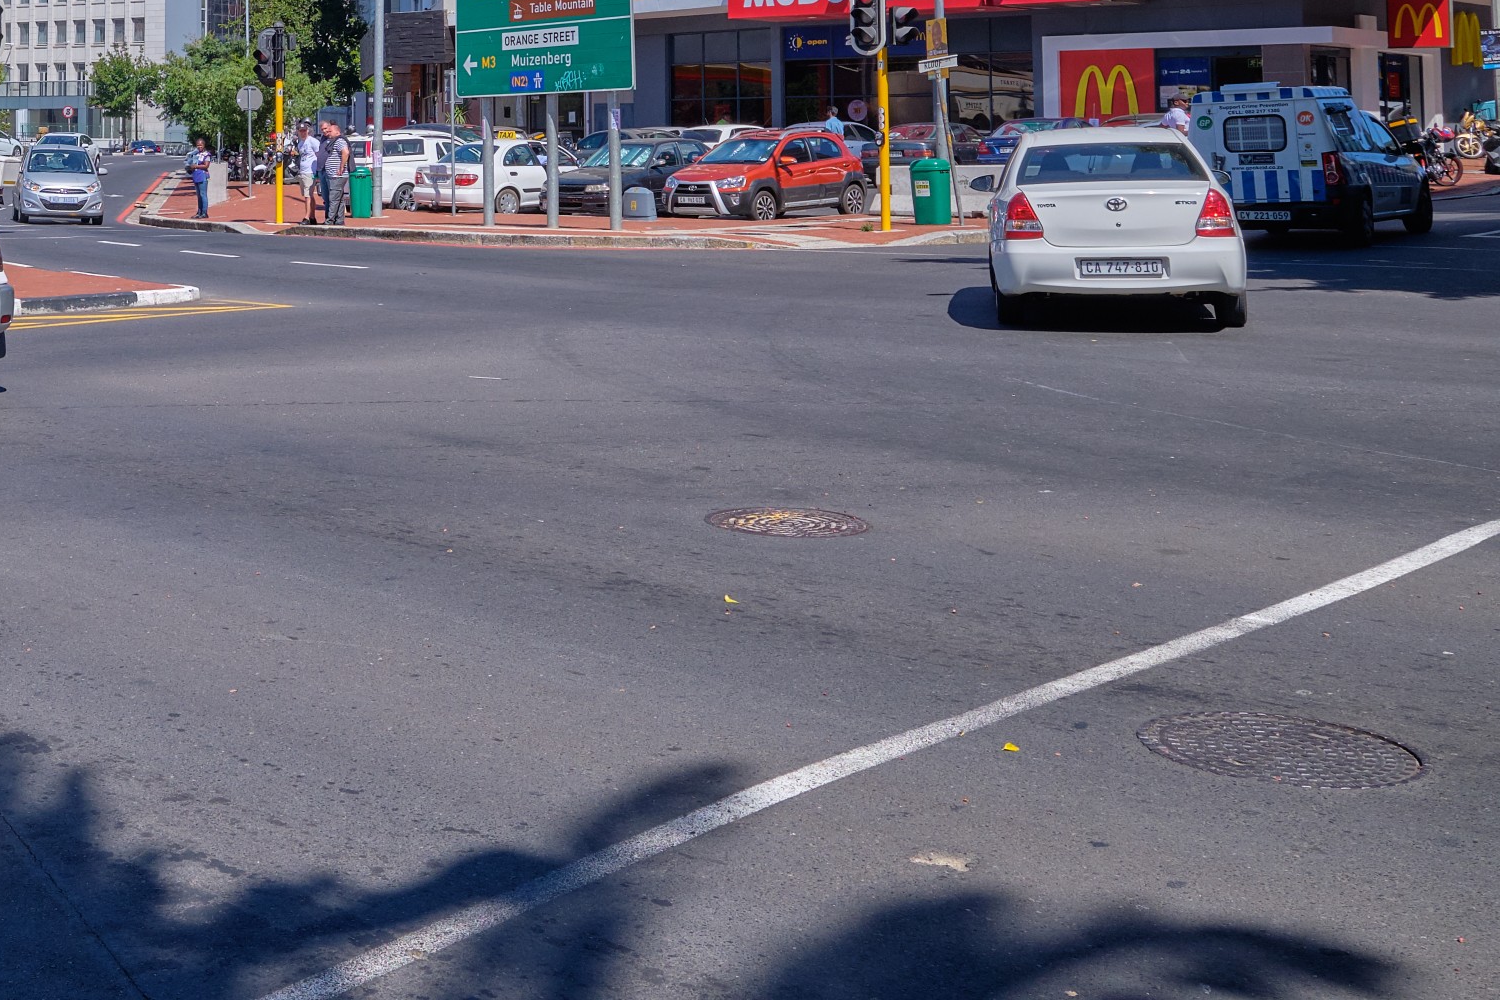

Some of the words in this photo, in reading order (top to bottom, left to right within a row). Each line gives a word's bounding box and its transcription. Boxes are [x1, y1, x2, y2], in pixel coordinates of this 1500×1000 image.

[530, 2, 552, 14] Table
[504, 33, 539, 47] ORANGE
[542, 30, 576, 43] STREET
[806, 38, 828, 46] open
[481, 55, 497, 69] M3
[511, 51, 572, 68] Muizenberg
[511, 75, 529, 88] (N2)
[1199, 119, 1211, 128] GP
[1299, 113, 1312, 123] OK
[499, 131, 514, 139] TAXI
[1240, 212, 1251, 220] CY
[1086, 261, 1102, 274] CA
